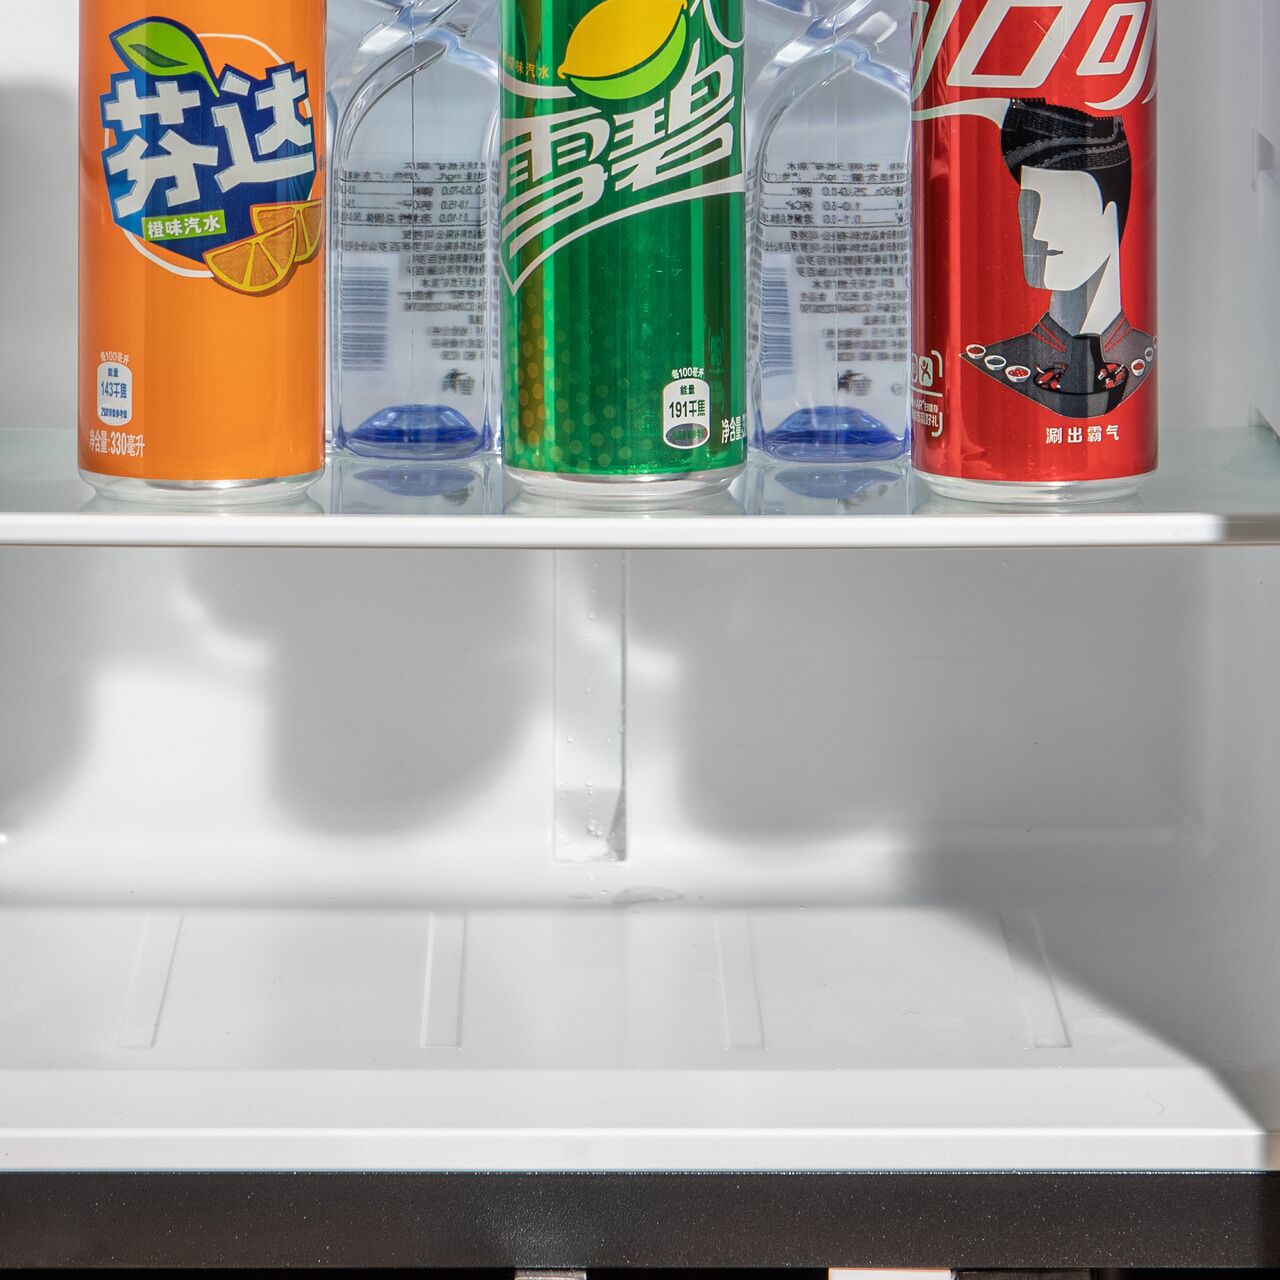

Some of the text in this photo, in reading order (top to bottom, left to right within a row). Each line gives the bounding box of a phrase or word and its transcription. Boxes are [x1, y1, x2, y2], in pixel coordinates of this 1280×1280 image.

[104, 69, 315, 219] 芬达
[500, 39, 735, 260] 雪碧
[147, 214, 222, 239] 橙味汽水
[669, 399, 706, 418] 191千焦
[1045, 424, 1120, 444] 涮出霸气
